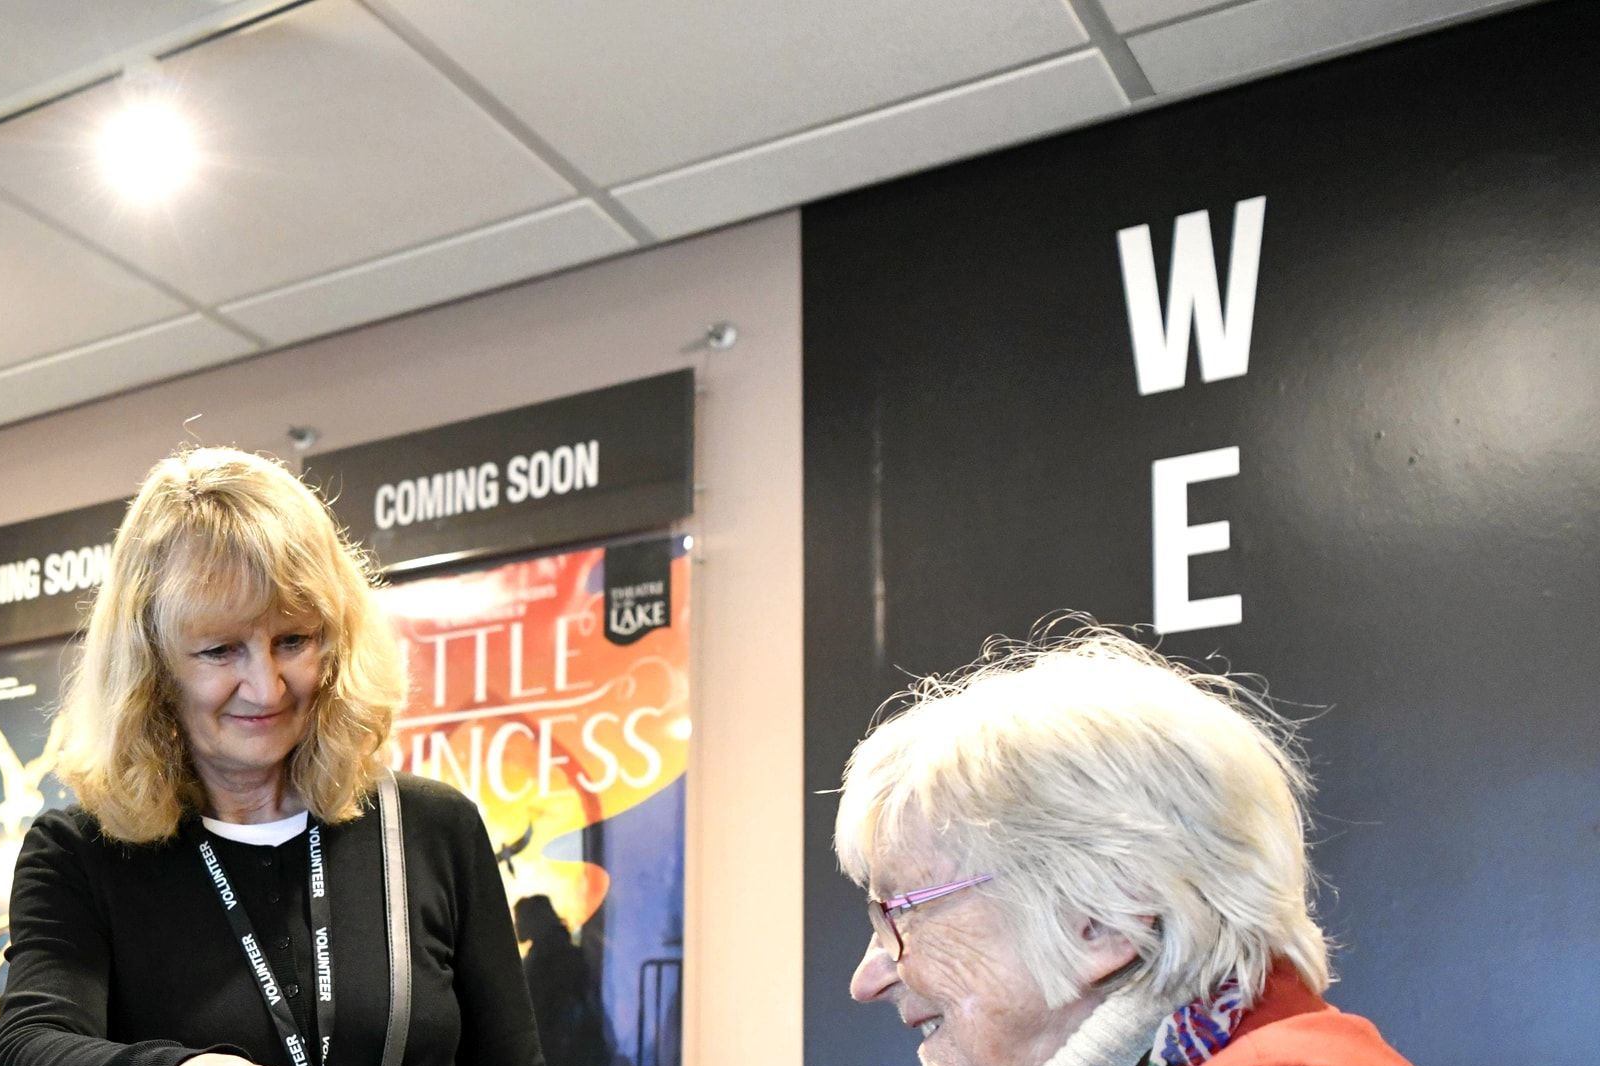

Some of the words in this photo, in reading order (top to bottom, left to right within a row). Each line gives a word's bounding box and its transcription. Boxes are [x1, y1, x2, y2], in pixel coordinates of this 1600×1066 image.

[374, 461, 500, 530] COMING
[505, 439, 600, 504] SOON
[610, 601, 666, 635] LAKE
[397, 607, 597, 712] ITTLE
[200, 840, 238, 910] VOLUNTEER
[308, 826, 325, 899] VOLUNTEER
[241, 933, 282, 1007] VOLUNTEER
[315, 927, 332, 1002] VOLUNTEER
